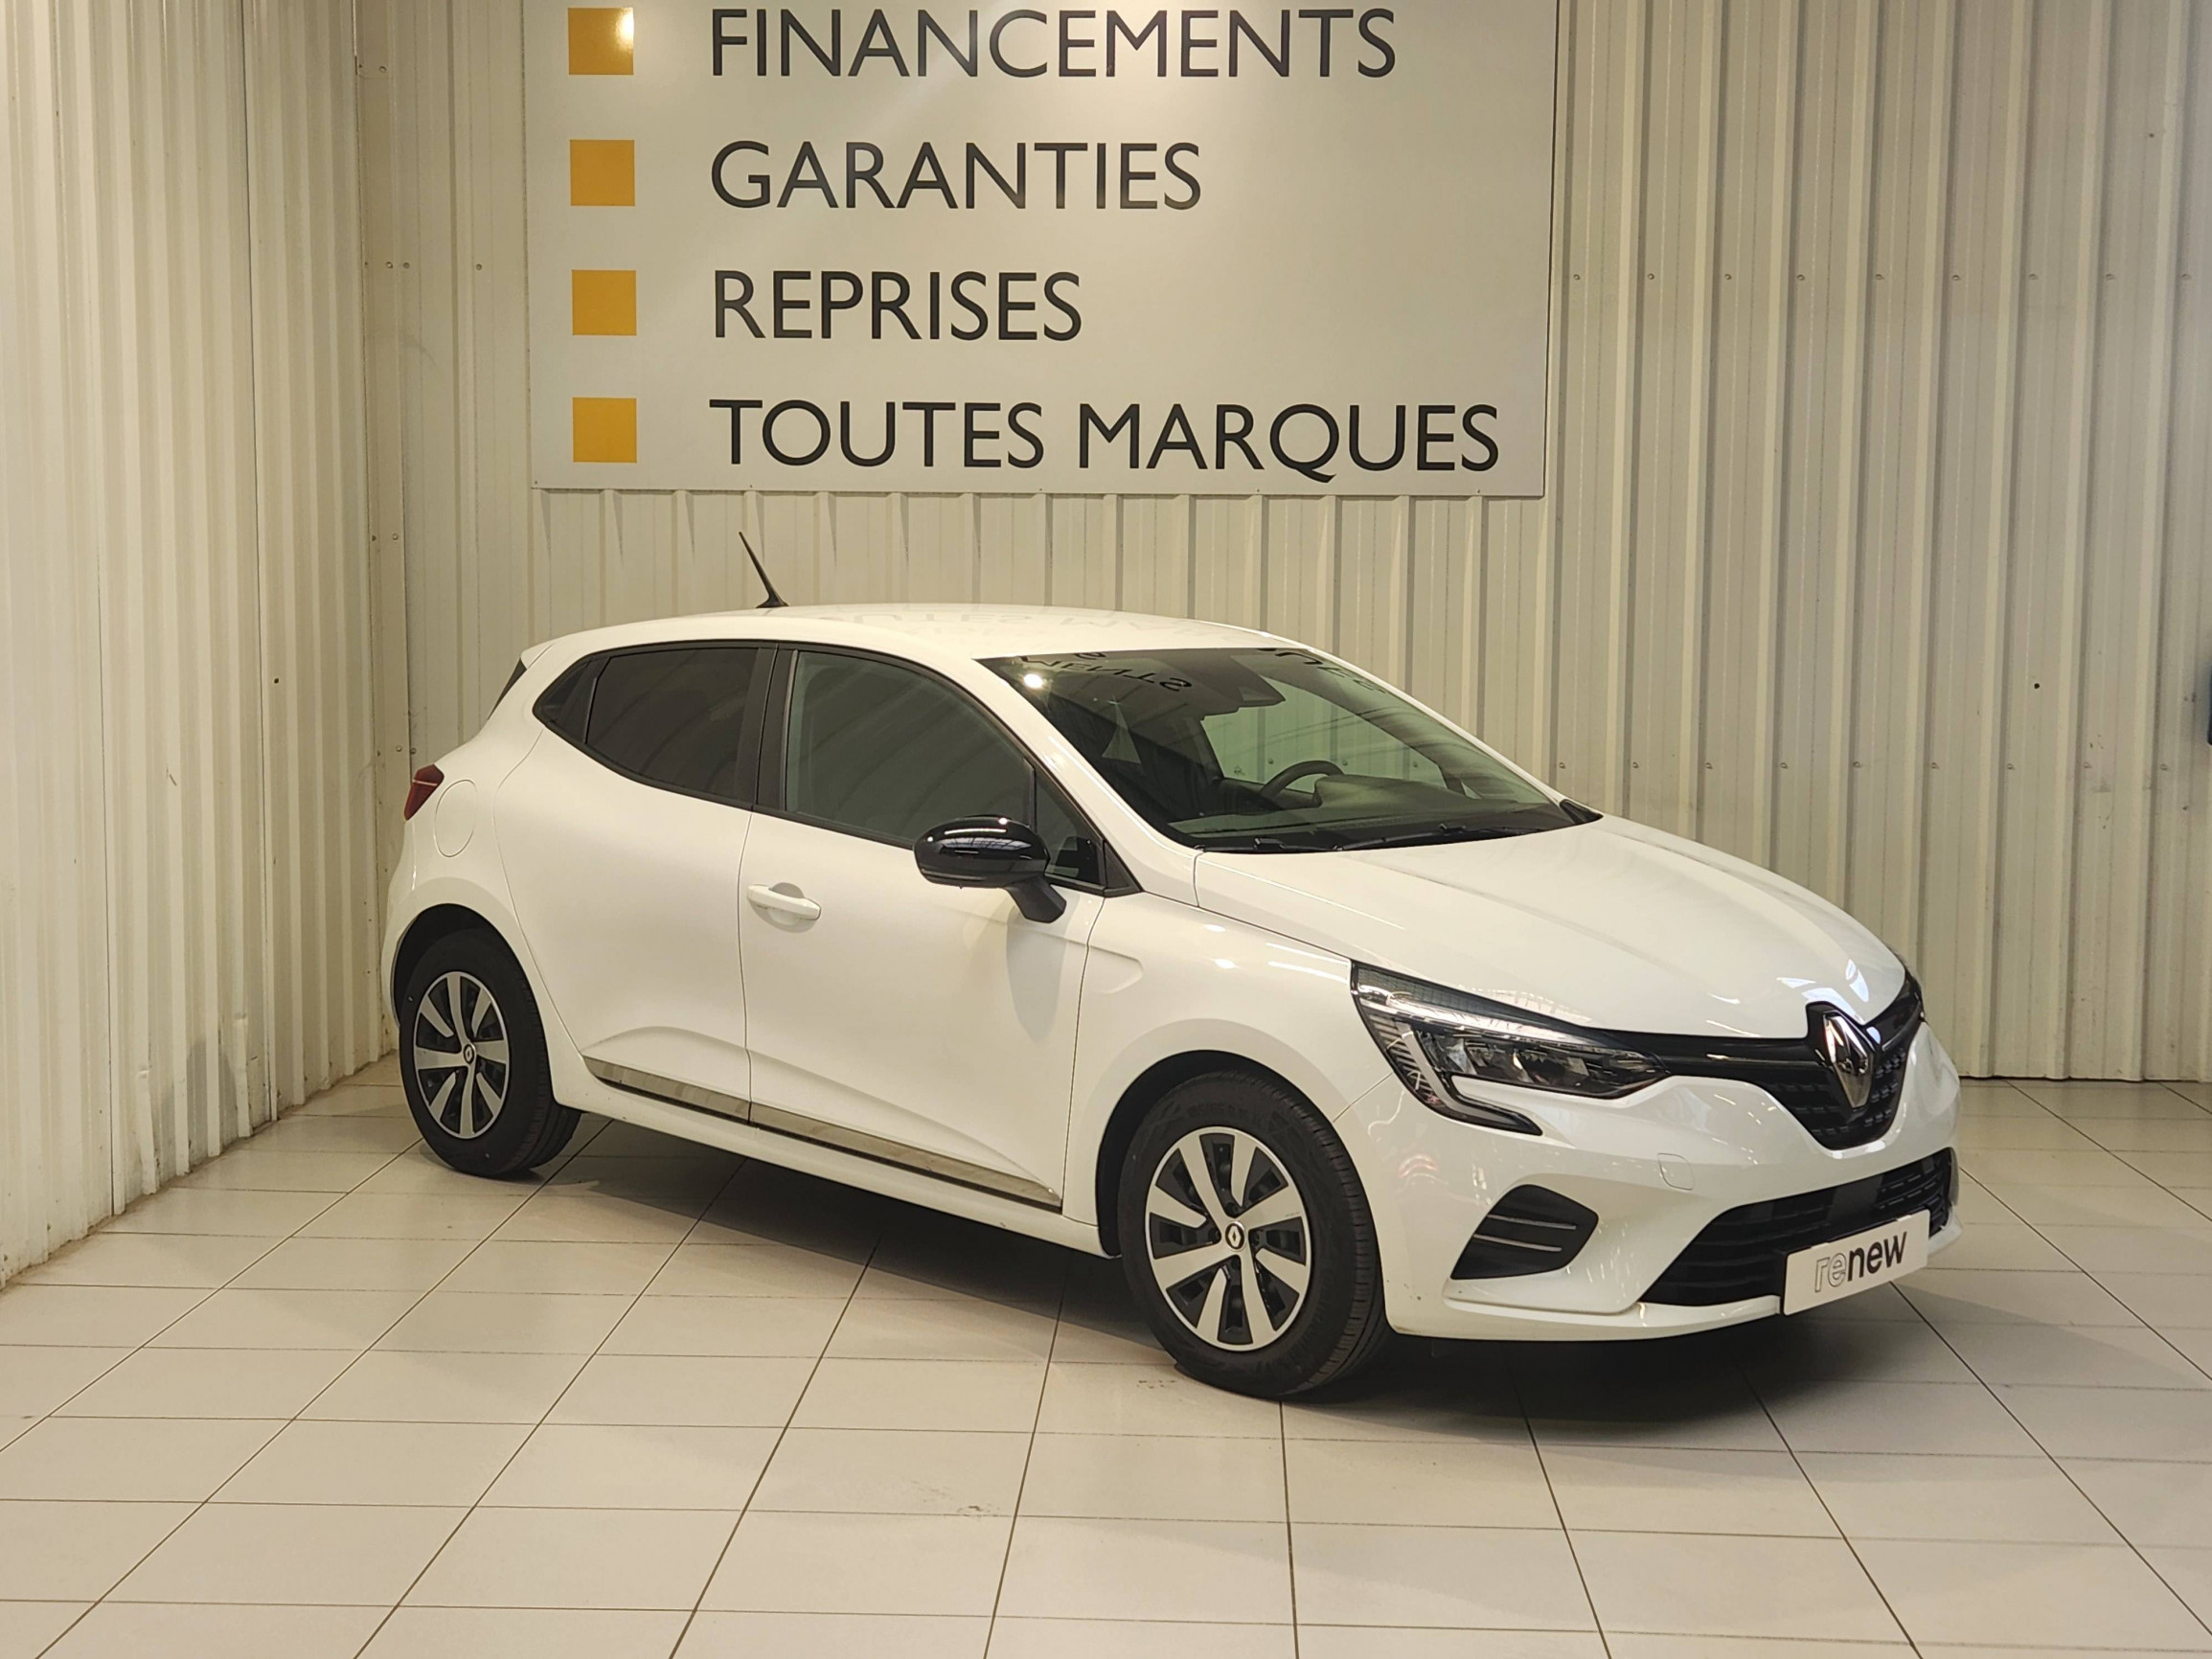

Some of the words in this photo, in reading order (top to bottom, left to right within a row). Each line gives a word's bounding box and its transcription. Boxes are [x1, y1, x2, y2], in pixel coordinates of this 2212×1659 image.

[712, 8, 1396, 79] FINANCEMENTS
[711, 140, 1201, 211] GARANTIES
[715, 269, 1082, 342] REPRISES
[709, 398, 1044, 469] TOUTES
[1079, 402, 1499, 484] MARQUES
[1814, 1231, 1907, 1293] renew
